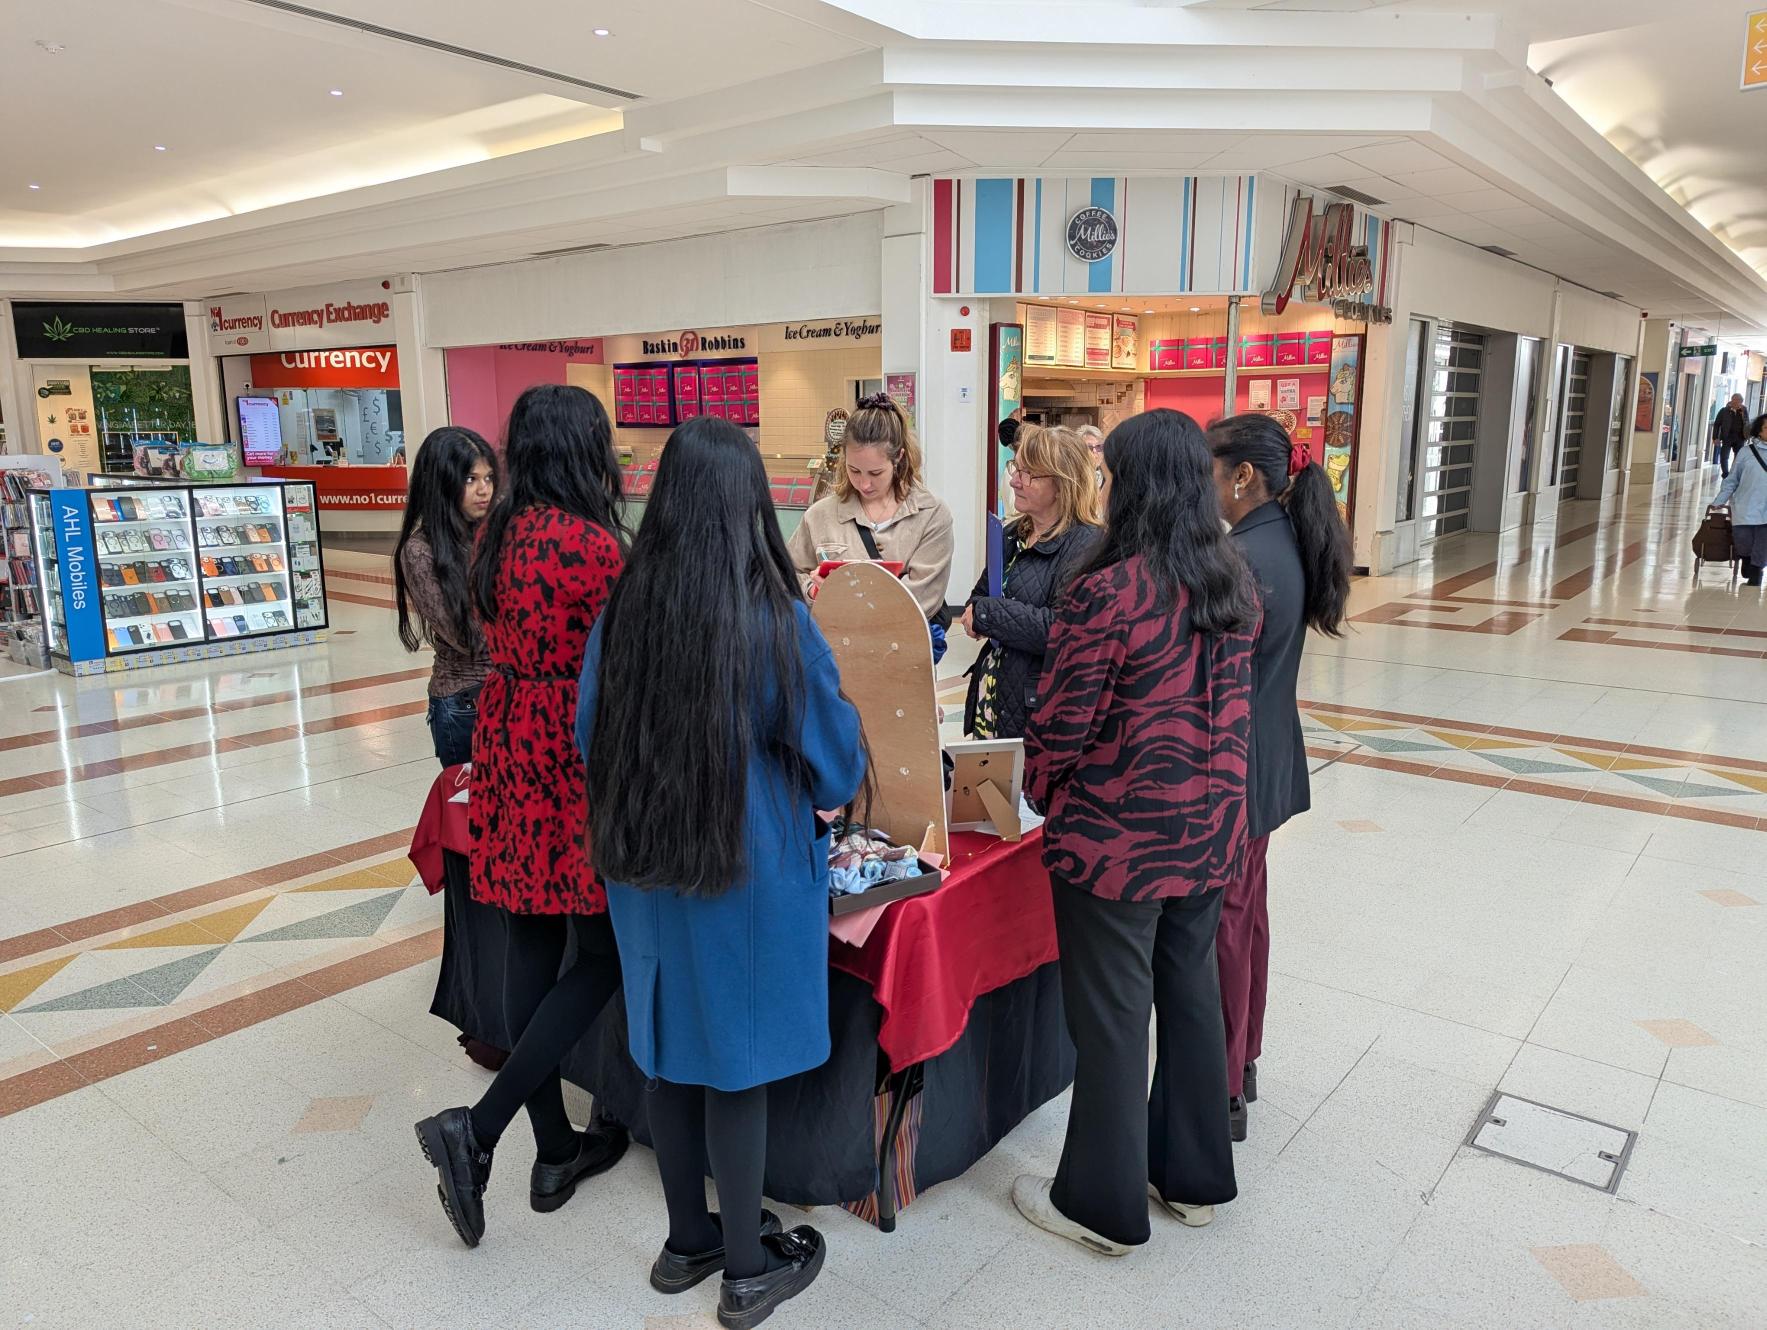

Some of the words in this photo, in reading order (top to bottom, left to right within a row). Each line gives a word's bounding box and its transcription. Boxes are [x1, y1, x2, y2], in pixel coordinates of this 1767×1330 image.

[1075, 210, 1108, 224] COFFEE
[1070, 224, 1116, 244] Millie's
[1074, 243, 1113, 259] COOKIES
[270, 308, 324, 329] Currency
[325, 301, 390, 325] Exchange
[785, 326, 798, 340] Ice
[799, 324, 832, 339] Cream
[833, 322, 843, 337] &
[843, 319, 882, 340] Yoghur
[514, 343, 548, 352] Cream
[549, 341, 559, 353] &
[559, 341, 595, 357] Yoghurt
[642, 338, 678, 355] Baskin
[700, 334, 746, 351] Robbins
[281, 350, 392, 374] Currency
[62, 505, 81, 542] AHL
[67, 546, 88, 610] Mobiles
